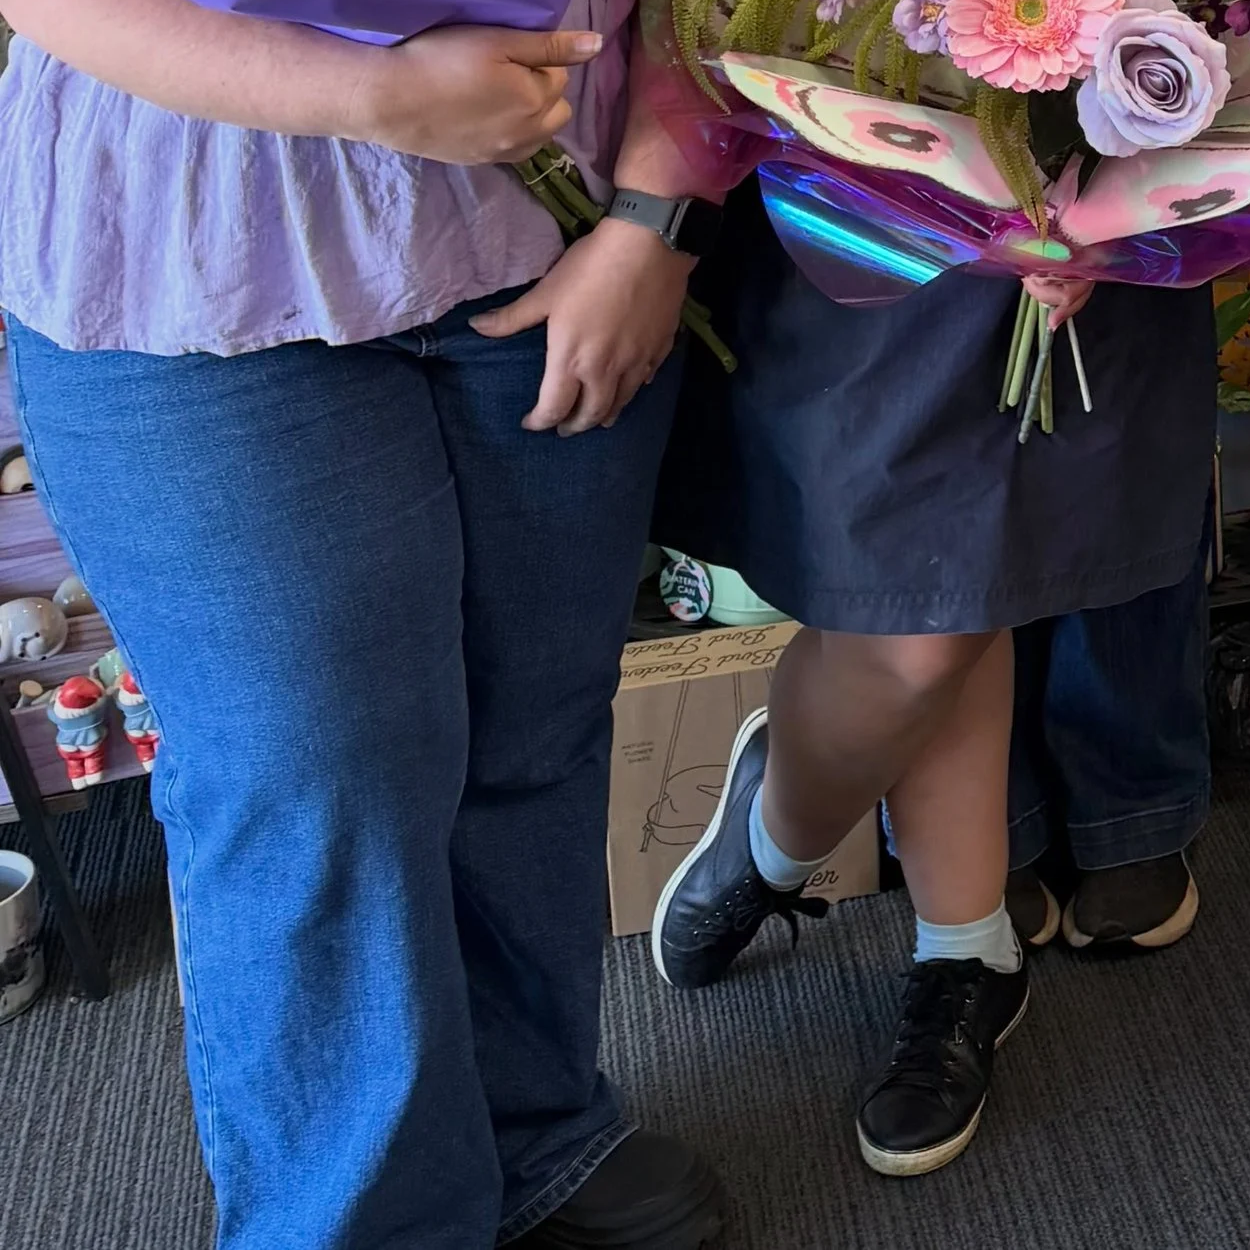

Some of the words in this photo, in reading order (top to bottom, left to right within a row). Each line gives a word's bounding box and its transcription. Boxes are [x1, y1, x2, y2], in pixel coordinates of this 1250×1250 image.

[677, 585, 696, 597] CAN
[625, 636, 702, 658] Feede
[708, 625, 776, 647] Bird
[717, 645, 785, 667] Bird
